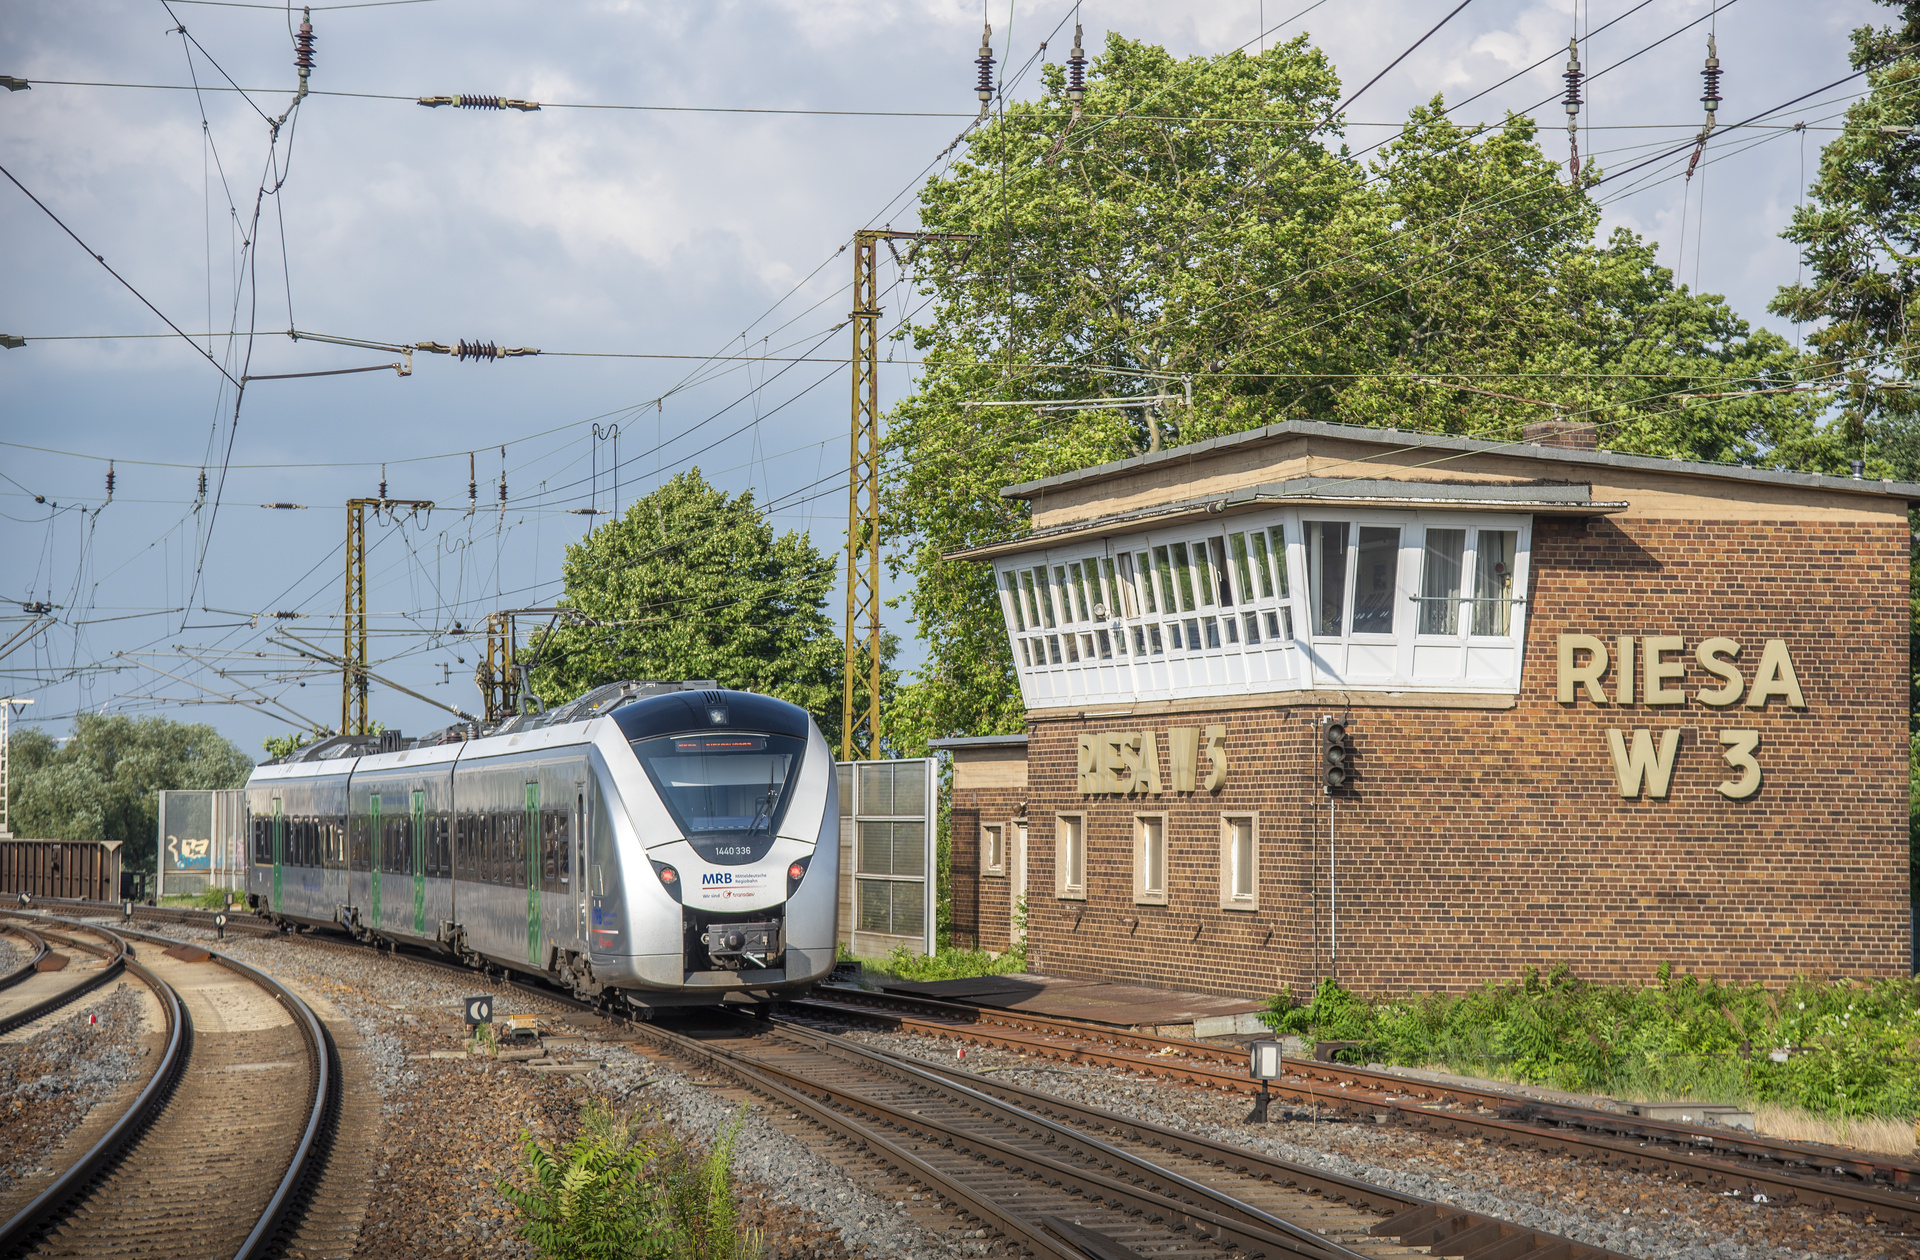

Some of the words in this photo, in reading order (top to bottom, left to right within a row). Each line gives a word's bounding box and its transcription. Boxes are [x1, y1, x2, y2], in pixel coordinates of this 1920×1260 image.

[1557, 633, 1806, 707] RIESA
[1168, 727, 1200, 792] W
[1203, 725, 1228, 791] 3
[1604, 728, 1681, 798] W
[1717, 729, 1762, 799] 3
[702, 872, 733, 885] MRB
[715, 847, 734, 855] 1440
[735, 846, 751, 855] 336
